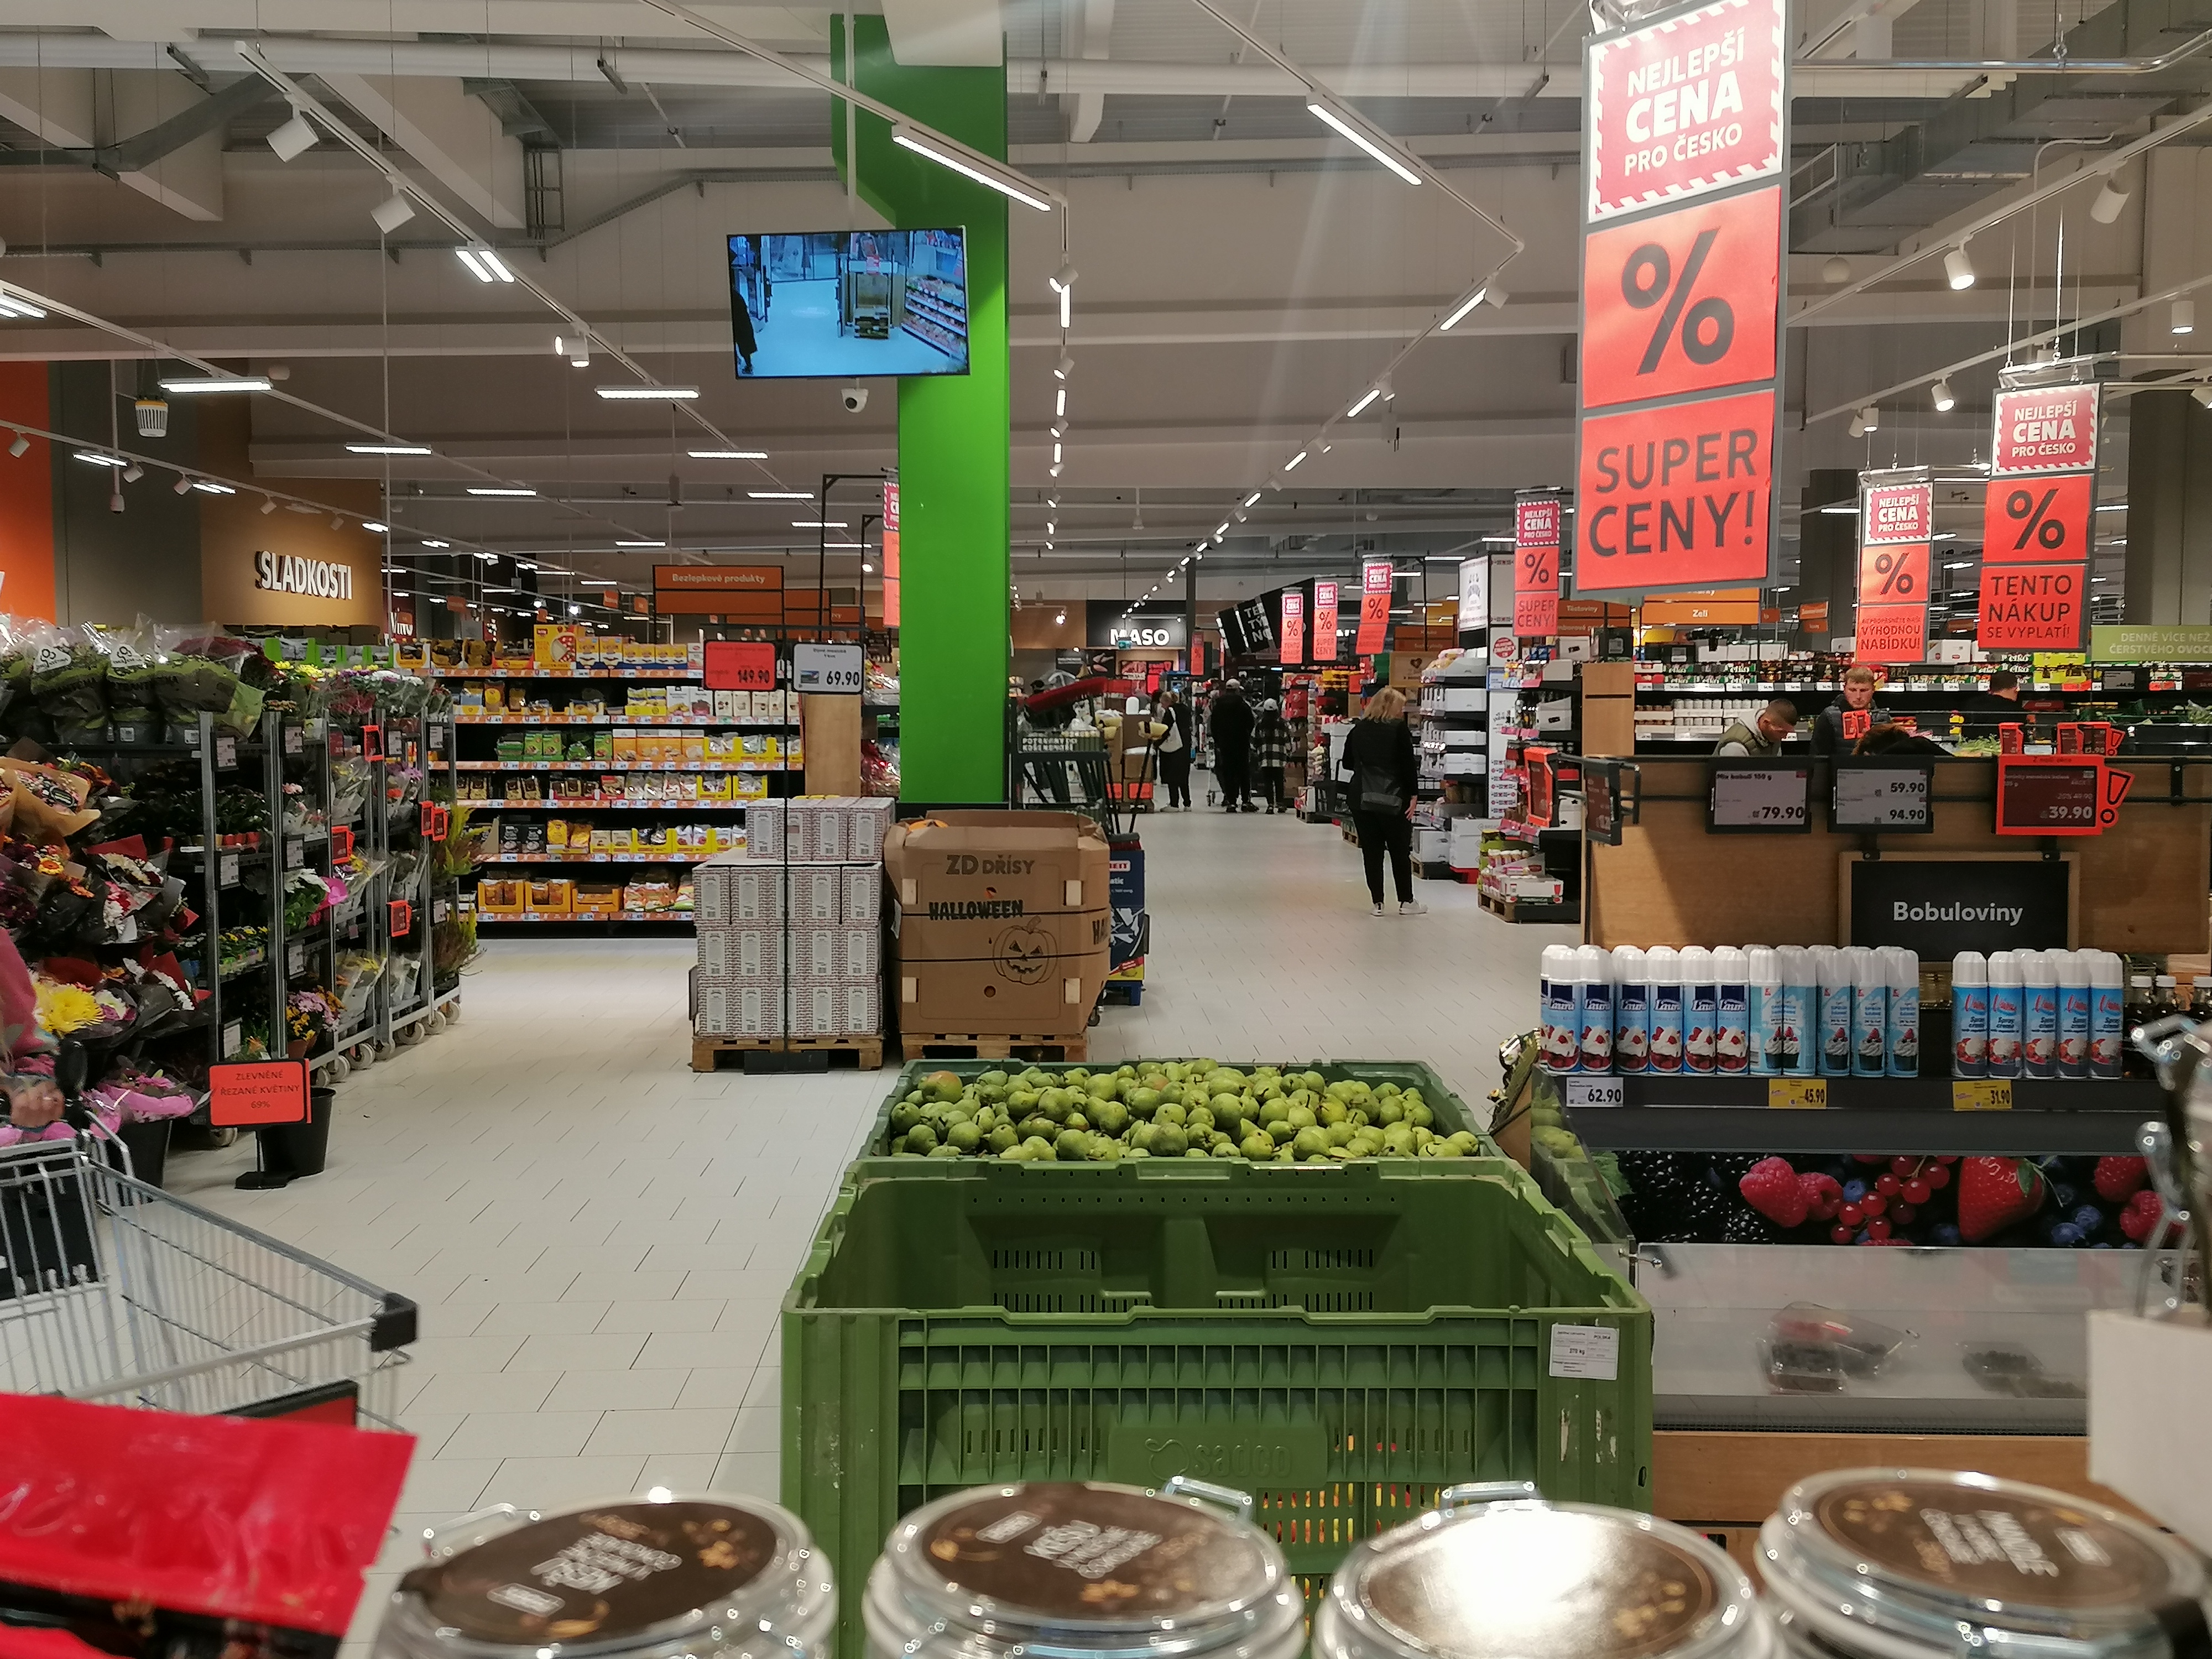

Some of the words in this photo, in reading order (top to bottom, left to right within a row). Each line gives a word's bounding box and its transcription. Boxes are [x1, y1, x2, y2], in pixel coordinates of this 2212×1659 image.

[1627, 27, 1745, 97] NEJLEPŠÍ
[1626, 71, 1744, 143] CENA
[1624, 145, 1667, 176] PRO
[1673, 123, 1743, 161] ČESKO
[1621, 227, 1735, 375] %
[2015, 400, 2077, 421] NEJLEPŠÍ
[2013, 419, 2076, 444] CENA
[2012, 446, 2036, 457] PRO
[2038, 442, 2076, 455] ČESKO
[1595, 429, 1758, 493] SUPER
[1879, 493, 1919, 508] NEJLEPŠÍ
[1878, 506, 1918, 523] CENA
[2006, 488, 2065, 550] %
[1524, 518, 1552, 530] CENA
[1590, 490, 1755, 556] CENY!
[1878, 524, 1893, 533] PRO
[1895, 521, 1918, 531] ČESKO
[262, 550, 352, 600] SLADKOSTI
[724, 574, 765, 584] produkty
[1875, 552, 1913, 594] %
[1991, 575, 2072, 596] TENTO
[1519, 600, 1555, 612] SUPER
[1988, 598, 2070, 622] NÁKUP
[1518, 614, 1555, 627] CENY!
[1110, 629, 1170, 646] MASO
[1861, 624, 1920, 636] VÝHODNOU
[1987, 627, 2003, 638] SE
[2007, 624, 2070, 639] VYPLATÍ!
[2161, 632, 2185, 642] VÍCE
[1861, 636, 1920, 650] NABÍDKU!
[2110, 644, 2174, 654] ČERSTVÉHO
[826, 670, 860, 685] 69.90
[1890, 782, 1925, 793] 59.90
[1762, 806, 1804, 818] 79.90
[1889, 809, 1925, 820] 94.90
[2048, 806, 2093, 819] 39.90
[946, 855, 979, 875] ZD
[982, 855, 1035, 874] DŘÍSY
[929, 900, 1023, 921] HALLOWEEN
[1893, 901, 2023, 926] Bobuloviny
[236, 1070, 283, 1080] ZLEVNĚNÉ
[221, 1085, 257, 1095] ŘEZANÉ
[260, 1084, 300, 1094] KVĚTINY
[1588, 1089, 1621, 1103] 62.90
[1804, 1088, 1825, 1103] 45.90
[1991, 1089, 2011, 1104] 31.90
[1194, 1438, 1291, 1477] sadco
